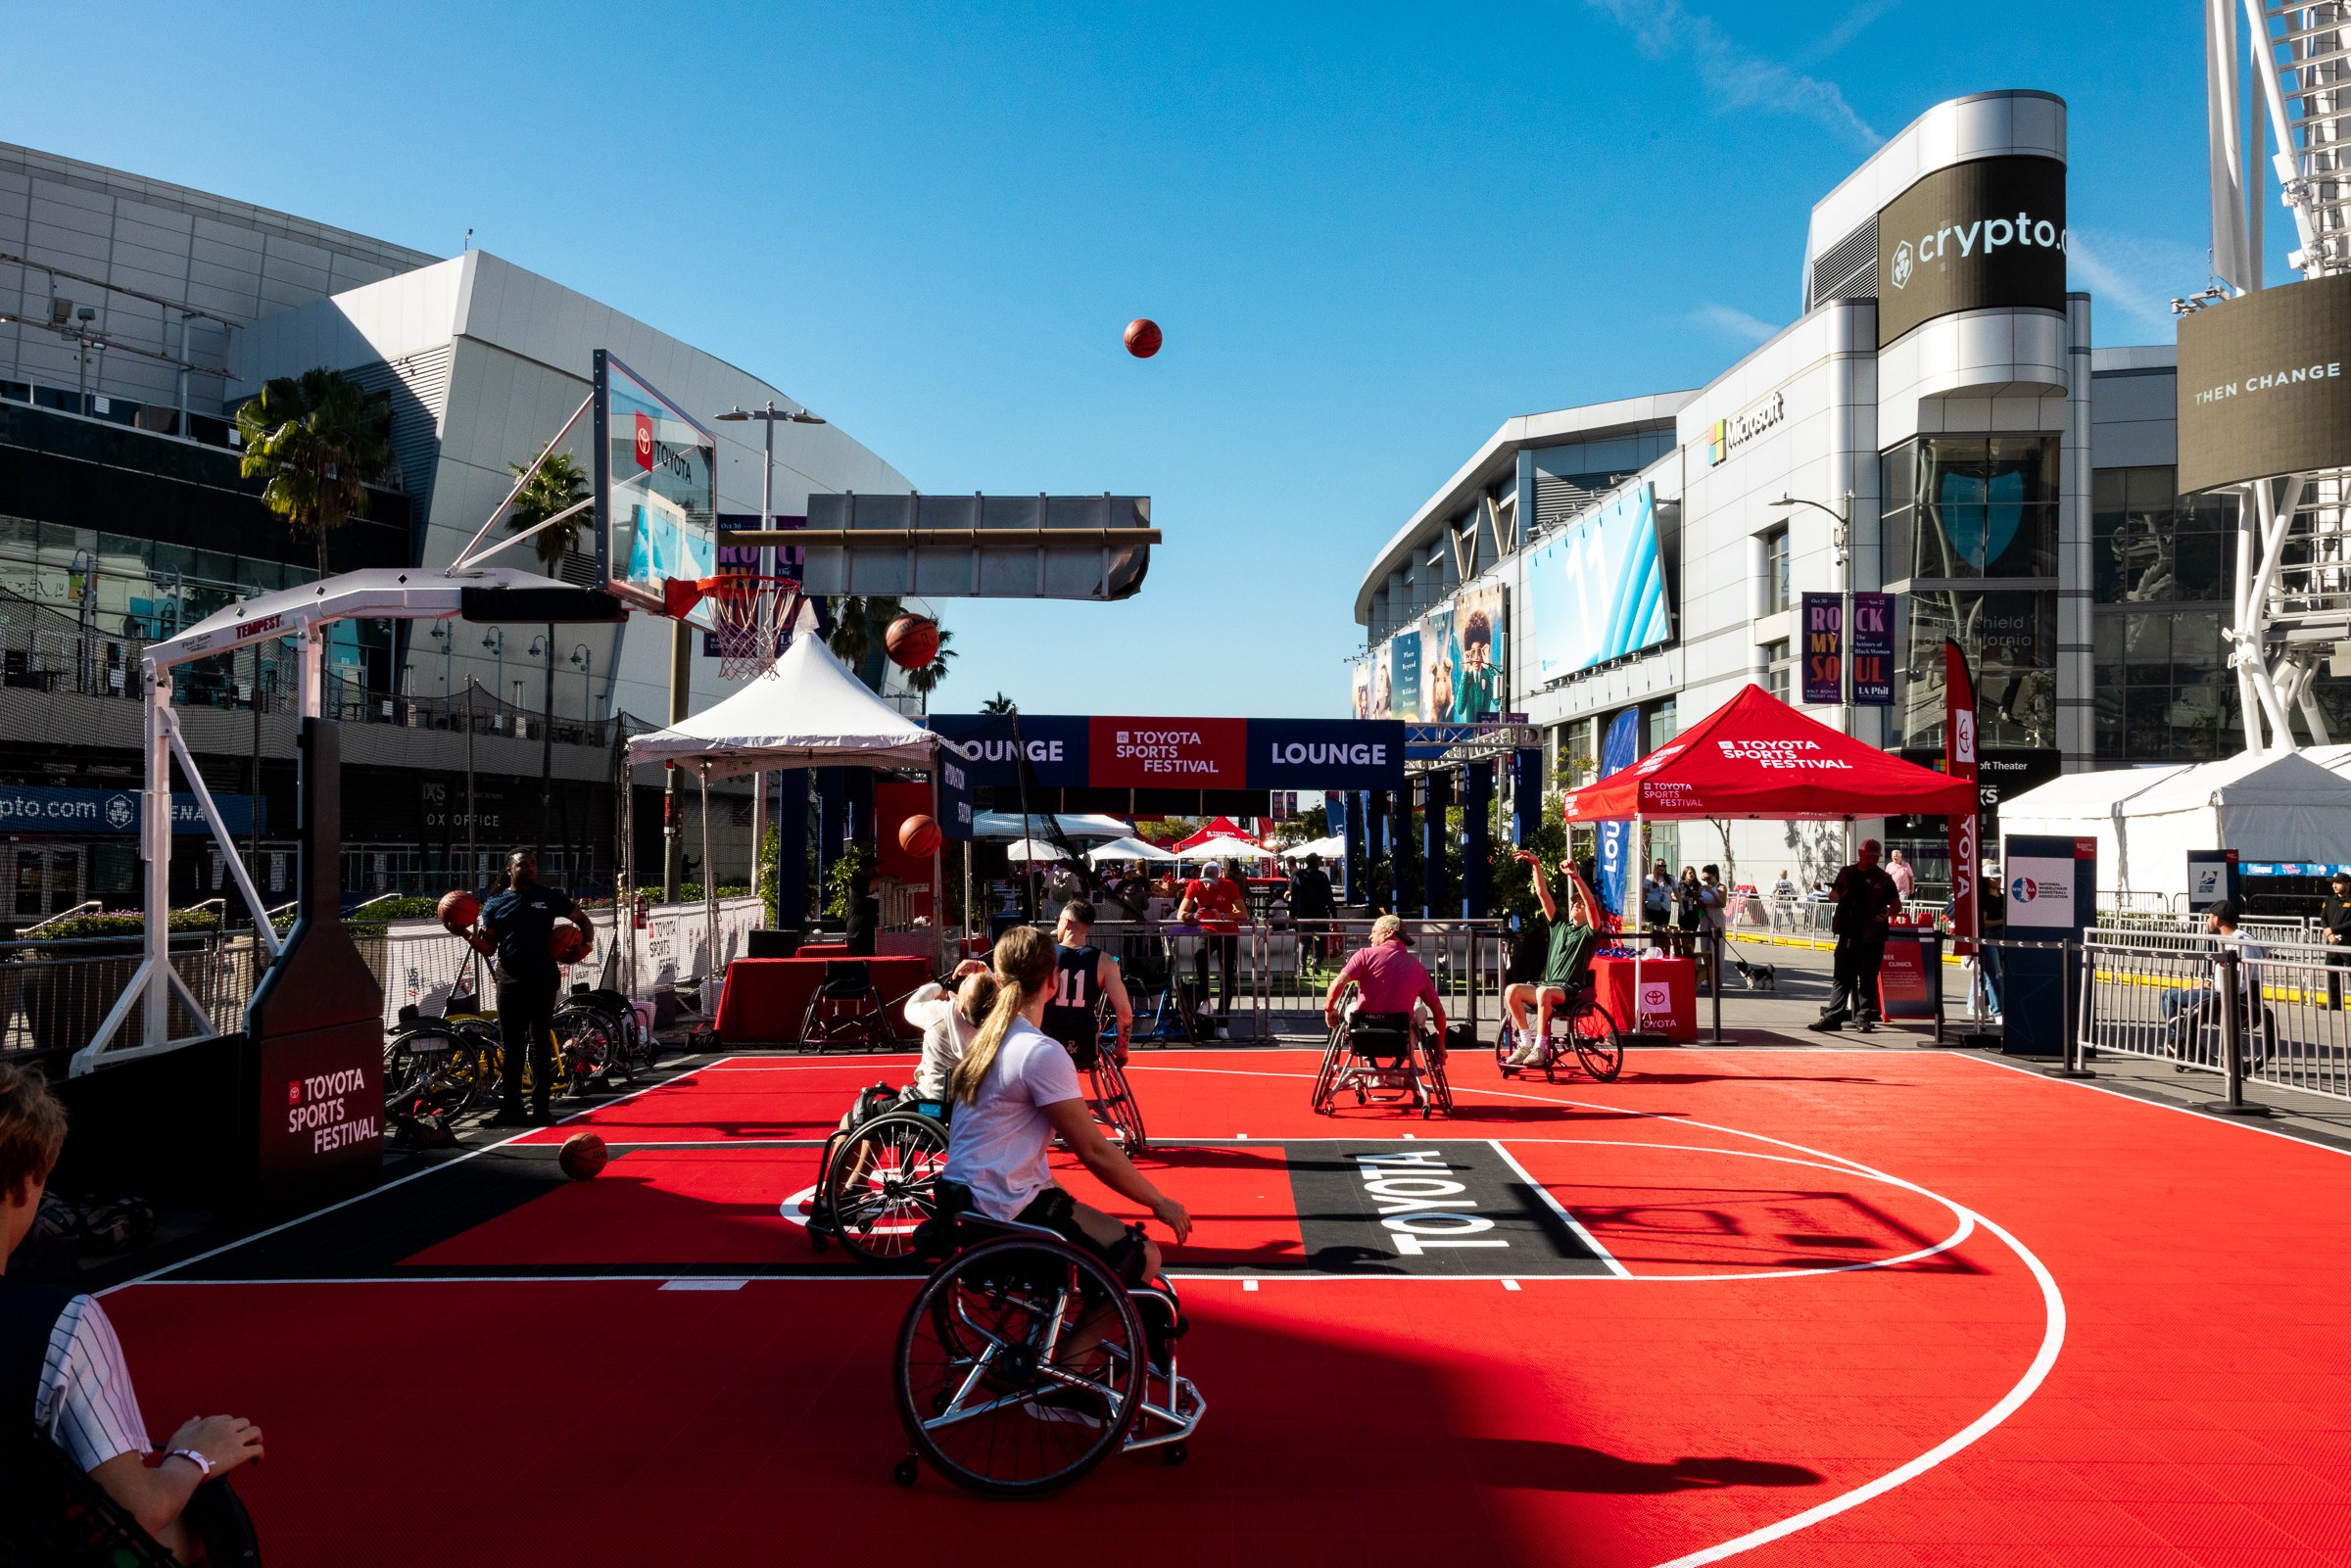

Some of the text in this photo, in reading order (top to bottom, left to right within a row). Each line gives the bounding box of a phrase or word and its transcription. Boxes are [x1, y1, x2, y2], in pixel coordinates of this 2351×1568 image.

[2194, 362, 2341, 406] THEN CHANGE
[1726, 392, 1783, 449] Microsoft
[655, 439, 693, 485] TOYOTA
[1565, 523, 1609, 655] 11
[235, 614, 281, 640] TEMPEST
[1975, 615, 2024, 629] Shield
[1811, 633, 1838, 653] MY
[1858, 687, 1889, 695] LA Phil
[1133, 732, 1201, 744] TOYOTA
[1738, 740, 1821, 750] TOYOTA
[955, 739, 1064, 762] OUNGE
[1116, 745, 1177, 758] SPORTS
[1272, 742, 1386, 765] LOUNGE
[1722, 749, 1798, 760] SPORTS
[1144, 760, 1219, 773] FESTIVAL
[1760, 759, 1853, 769] FESTIVAL
[1992, 761, 2029, 771] Theater
[1644, 790, 1680, 799] SPORTS
[1660, 798, 1703, 807] FESTIVAL
[0, 796, 207, 822] pto.com ENA
[426, 814, 446, 826] OX
[1605, 821, 1620, 874] LOU
[1957, 815, 1971, 899] YOTA
[1055, 969, 1085, 1008] 11
[1643, 1020, 1677, 1028] OYOTA
[305, 1068, 364, 1102] TOYOTA
[289, 1098, 345, 1133] SPORTS
[314, 1116, 379, 1154] FESTIVAL
[1356, 1150, 1511, 1256] TOYOTA
